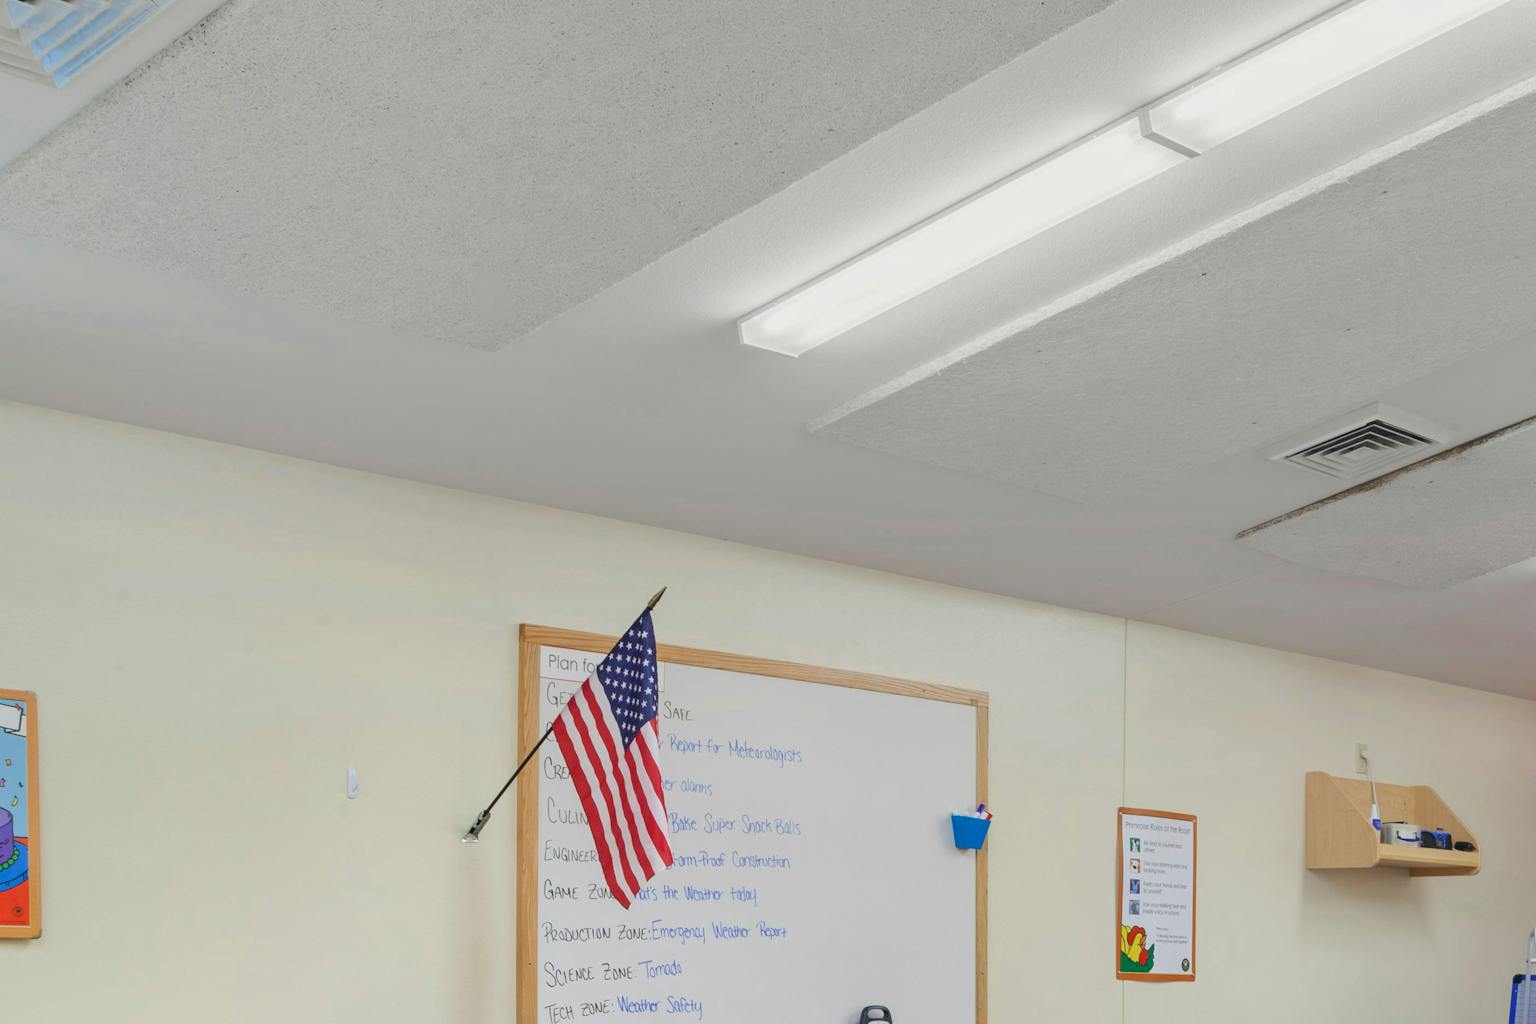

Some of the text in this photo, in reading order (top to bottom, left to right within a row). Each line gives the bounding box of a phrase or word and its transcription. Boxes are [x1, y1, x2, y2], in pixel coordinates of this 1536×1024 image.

[548, 654, 598, 673] Plan fo
[667, 733, 702, 755] Report
[706, 738, 722, 753] for
[729, 738, 802, 768] Meteorologists
[669, 812, 697, 833] Bake
[704, 812, 736, 834] Super
[741, 814, 772, 834] Snack
[775, 817, 801, 836] Balls
[732, 850, 790, 868] Construction
[543, 878, 578, 900] GAME
[588, 883, 615, 900] ZON
[661, 884, 679, 900] the
[684, 885, 722, 900] Weather
[731, 886, 757, 906] today
[541, 919, 788, 945] PRODUCTION ZONE: Emergency Weather Report
[544, 961, 595, 988] SCIENCE
[545, 995, 703, 1024] TECH ZONE: Weather Safety
